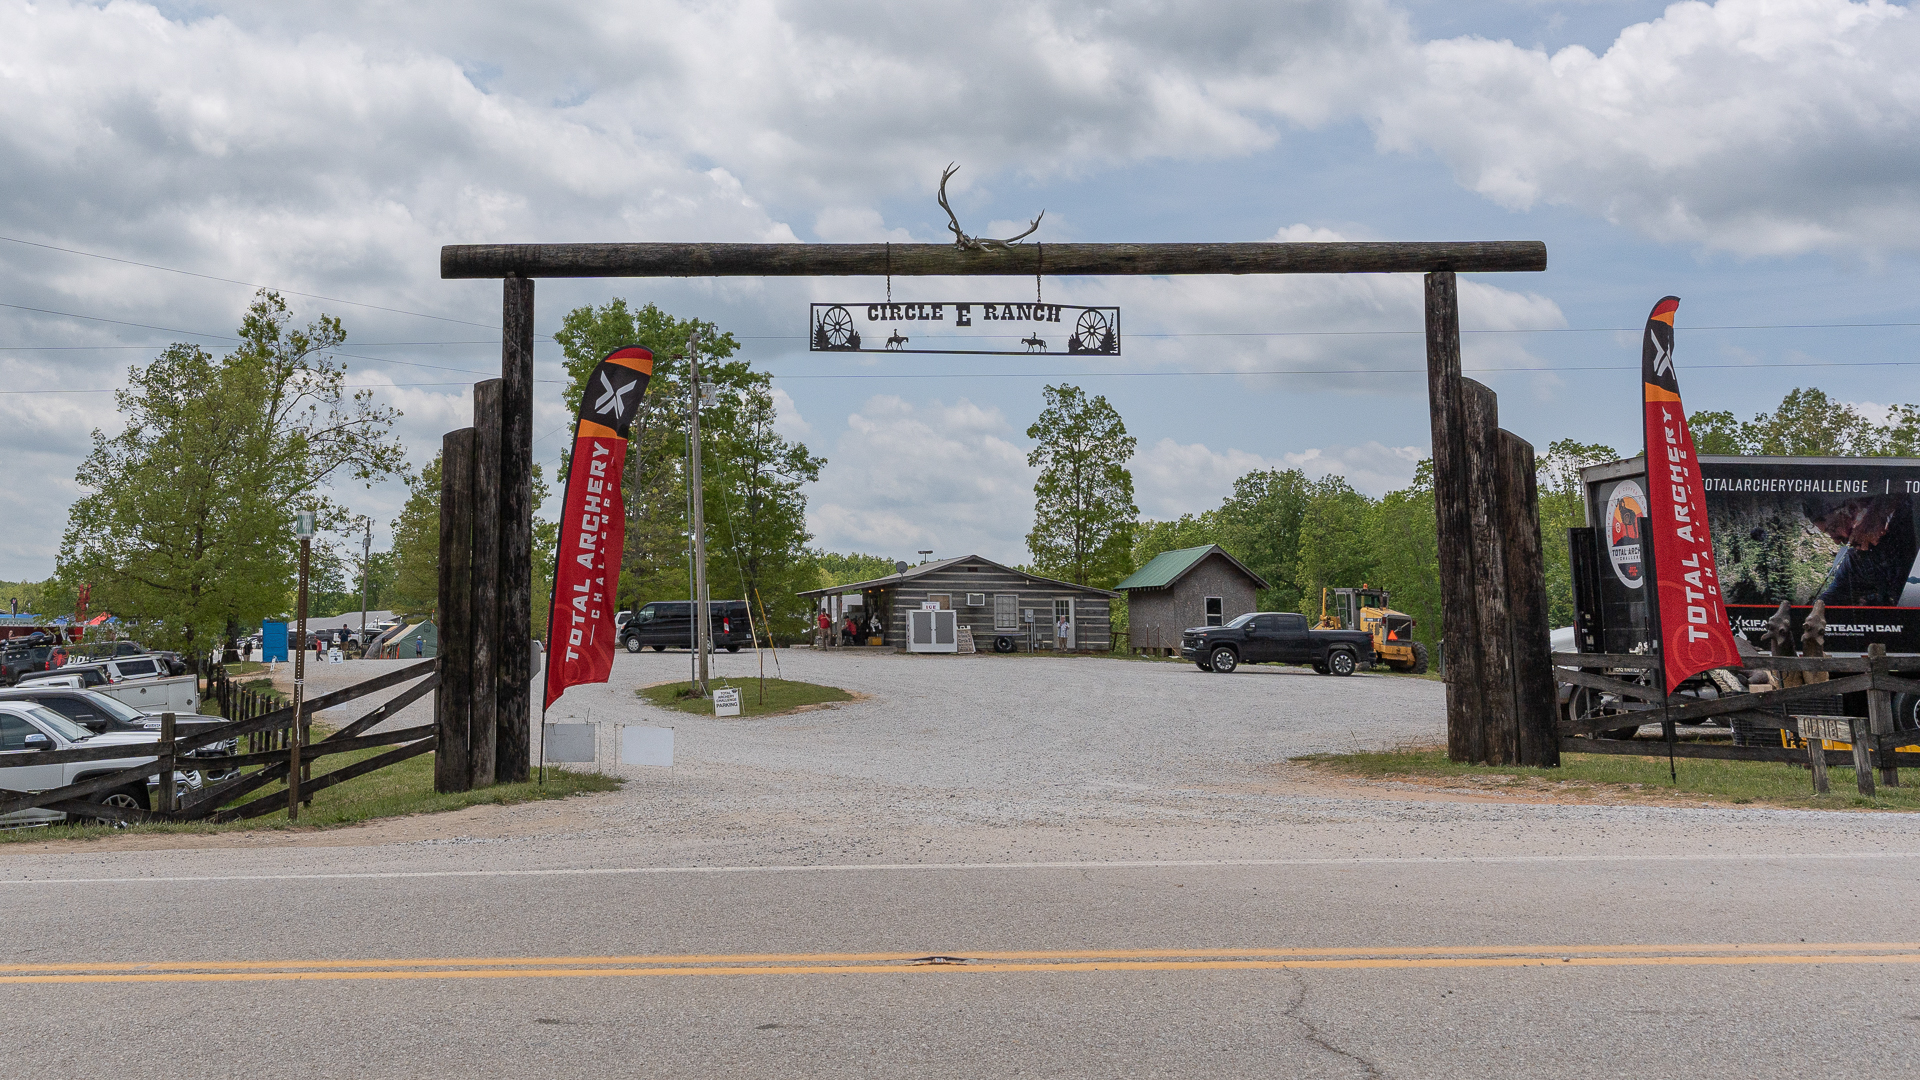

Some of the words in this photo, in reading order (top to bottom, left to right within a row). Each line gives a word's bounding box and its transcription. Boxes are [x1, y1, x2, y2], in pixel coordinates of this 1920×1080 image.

[867, 303, 943, 321] CIRCLE
[956, 304, 971, 327] E
[983, 304, 1062, 323] RANCH
[1661, 406, 1695, 543] ARCHERY
[1702, 478, 1868, 493] OTALARCHERYCHALLENGE
[1905, 480, 1920, 494] TO
[577, 440, 610, 570] ARCHERY
[591, 482, 613, 619] CHALLENGE
[1612, 548, 1627, 557] TOTAL
[565, 579, 591, 662] TOTAL
[1682, 553, 1709, 642] TOTAL
[1824, 624, 1874, 632] STEALTH
[1875, 624, 1902, 633] CAM
